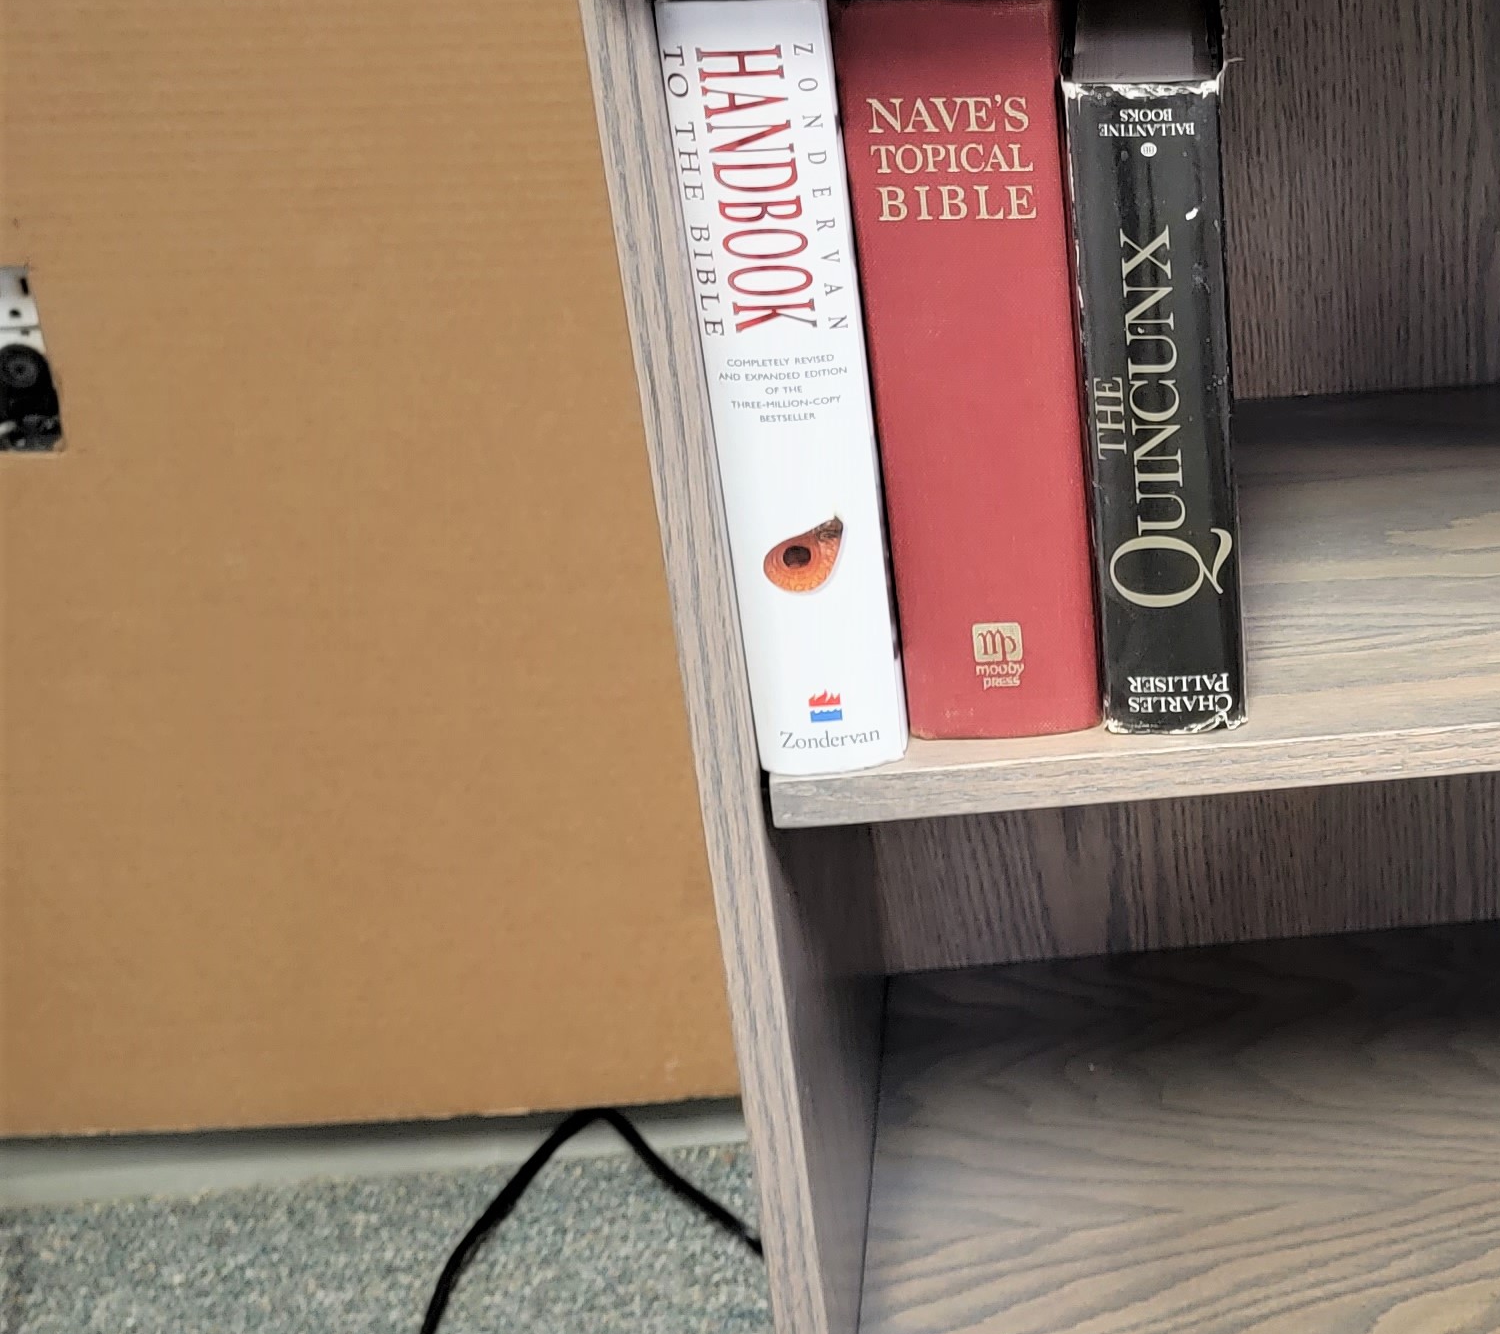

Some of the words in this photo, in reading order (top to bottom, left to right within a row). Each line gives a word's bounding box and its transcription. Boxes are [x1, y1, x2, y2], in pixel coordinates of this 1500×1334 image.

[663, 46, 690, 98] TO
[866, 94, 1029, 133] NAVE'S
[1119, 108, 1172, 122] BOOKS
[1098, 122, 1195, 137] BALLANTINE
[674, 121, 705, 201] THE
[870, 143, 1034, 174] TOPICAL
[695, 44, 817, 333] HANDBOOK
[793, 42, 848, 330] ZONDERVAN
[876, 184, 1037, 221] BIBLE
[690, 224, 725, 336] BIBLE
[718, 372, 741, 381] AND
[745, 371, 801, 381] EXPANDED
[804, 366, 848, 378] EDITION
[726, 357, 790, 367] COMPLETELY
[794, 354, 835, 365] REVISED
[731, 395, 841, 409] THREE-MILLION-COPY
[765, 386, 779, 395] OF
[782, 385, 803, 394] THE
[759, 412, 817, 423] BESTSELLER
[1093, 376, 1127, 460] THE
[1109, 224, 1233, 608] QUINCUNX
[1127, 672, 1230, 693] PALLISER
[1128, 693, 1233, 713] CHARLES
[779, 729, 881, 749] Zondervan
